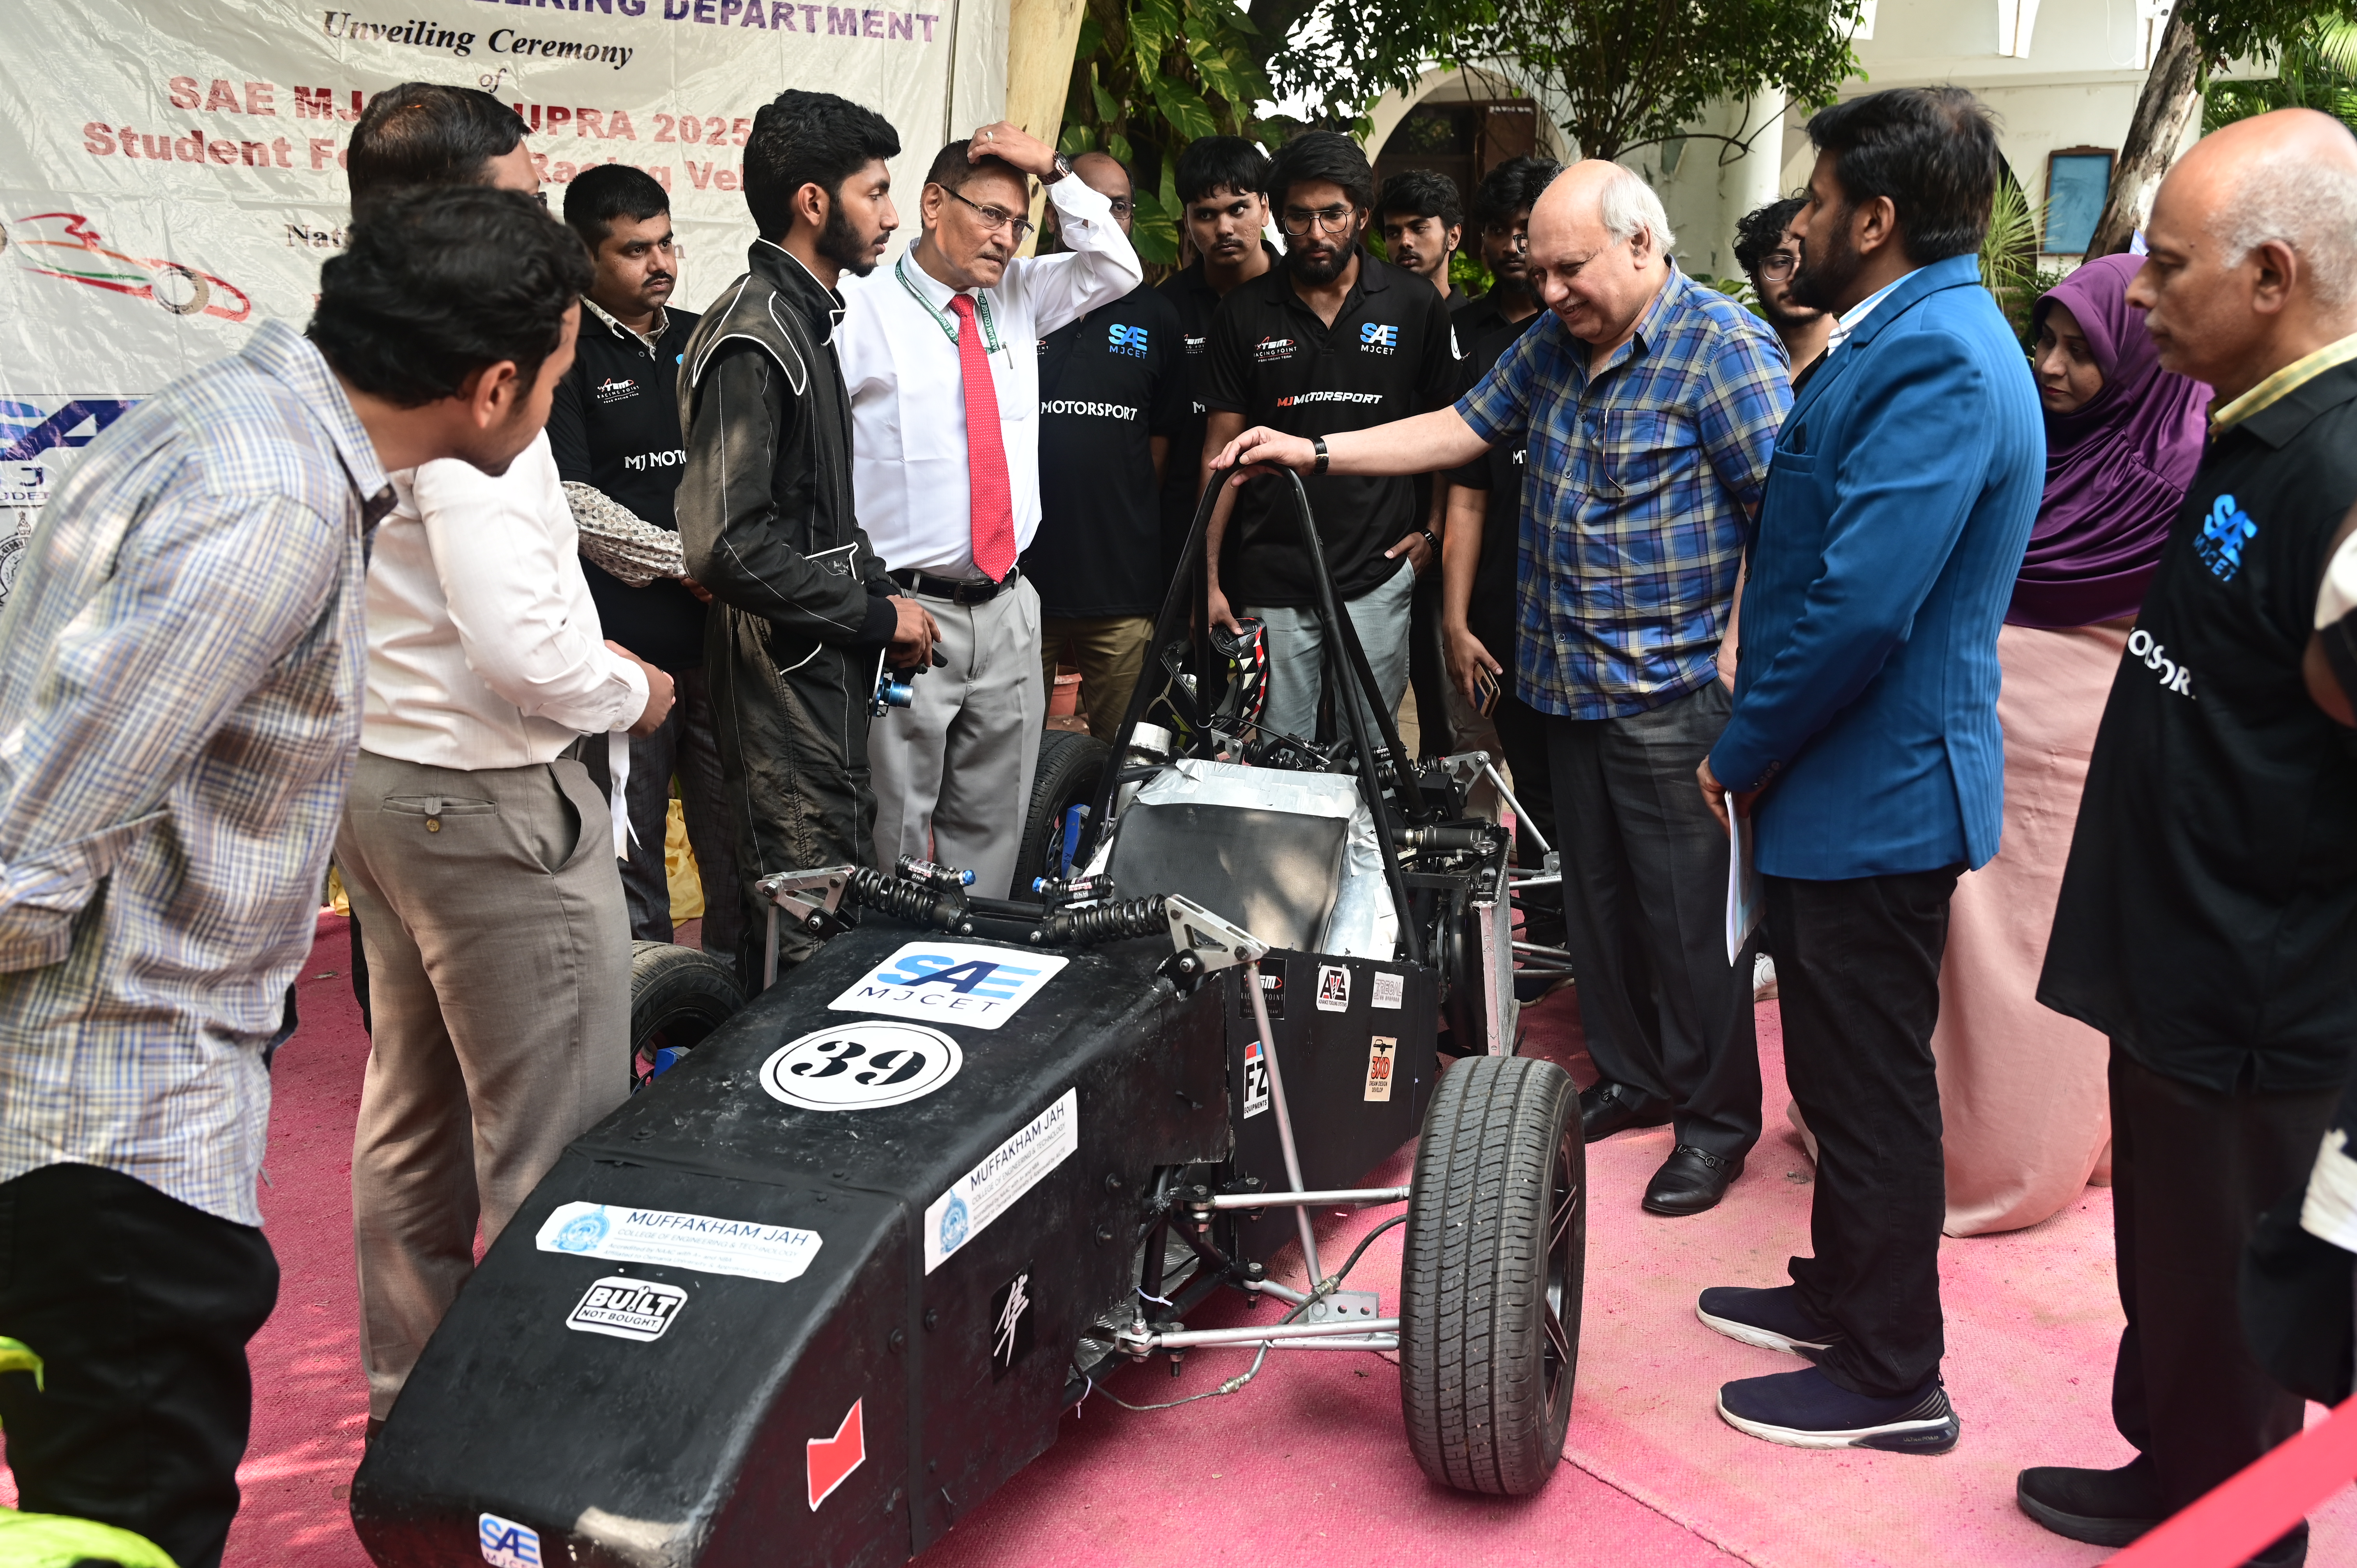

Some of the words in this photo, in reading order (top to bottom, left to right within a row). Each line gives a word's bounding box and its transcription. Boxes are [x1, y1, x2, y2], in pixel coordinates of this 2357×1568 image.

[664, 0, 938, 42] DEPARTMENT
[323, 11, 475, 57] Unveiling
[488, 28, 633, 70] Ceremony
[479, 68, 507, 93] of
[169, 76, 275, 116] SAE
[513, 103, 636, 141] UPRA
[652, 113, 751, 147] 2025
[83, 122, 292, 169] Student
[982, 304, 991, 327] COLLEGE
[947, 329, 956, 337] OF
[987, 327, 995, 339] JAH
[1108, 324, 1148, 351] SAE
[1360, 323, 1398, 346] SAE
[1109, 345, 1147, 359] MJCET
[1360, 344, 1394, 356] MJCET
[597, 390, 620, 399] RACING
[1041, 400, 1137, 421] MOTORSPORT
[625, 454, 646, 471] MJ
[912, 873, 927, 882] DNM
[1074, 891, 1088, 899] DNM
[877, 955, 1042, 999] SAE
[1320, 969, 1346, 1001] ATS
[857, 987, 1000, 1012] MJCET
[791, 1040, 926, 1086] 39
[1371, 1056, 1390, 1079] 3XD
[1245, 1060, 1267, 1102] FZ
[1244, 1100, 1267, 1114] EQUIPMENTS
[970, 1121, 1041, 1191] MUFFAKHAM
[1044, 1101, 1064, 1130] JAH
[972, 1182, 994, 1205] COLLEGE
[995, 1175, 1001, 1187] OF
[1002, 1151, 1031, 1181] ENGINEERING
[1037, 1122, 1065, 1150] TECHNOLOGY
[626, 1211, 762, 1238] MUFFAKHAM
[763, 1229, 809, 1246] JAH
[608, 1243, 645, 1252] Accredited
[618, 1229, 656, 1239] COLLEGE
[671, 1234, 728, 1247] ENGINEERING
[740, 1243, 798, 1257] TECHNOLOGY
[643, 1254, 672, 1262] Osmania
[673, 1257, 707, 1267] University
[586, 1286, 678, 1316] BUILT
[581, 1309, 606, 1319] NOT
[481, 1518, 539, 1565] SAE
